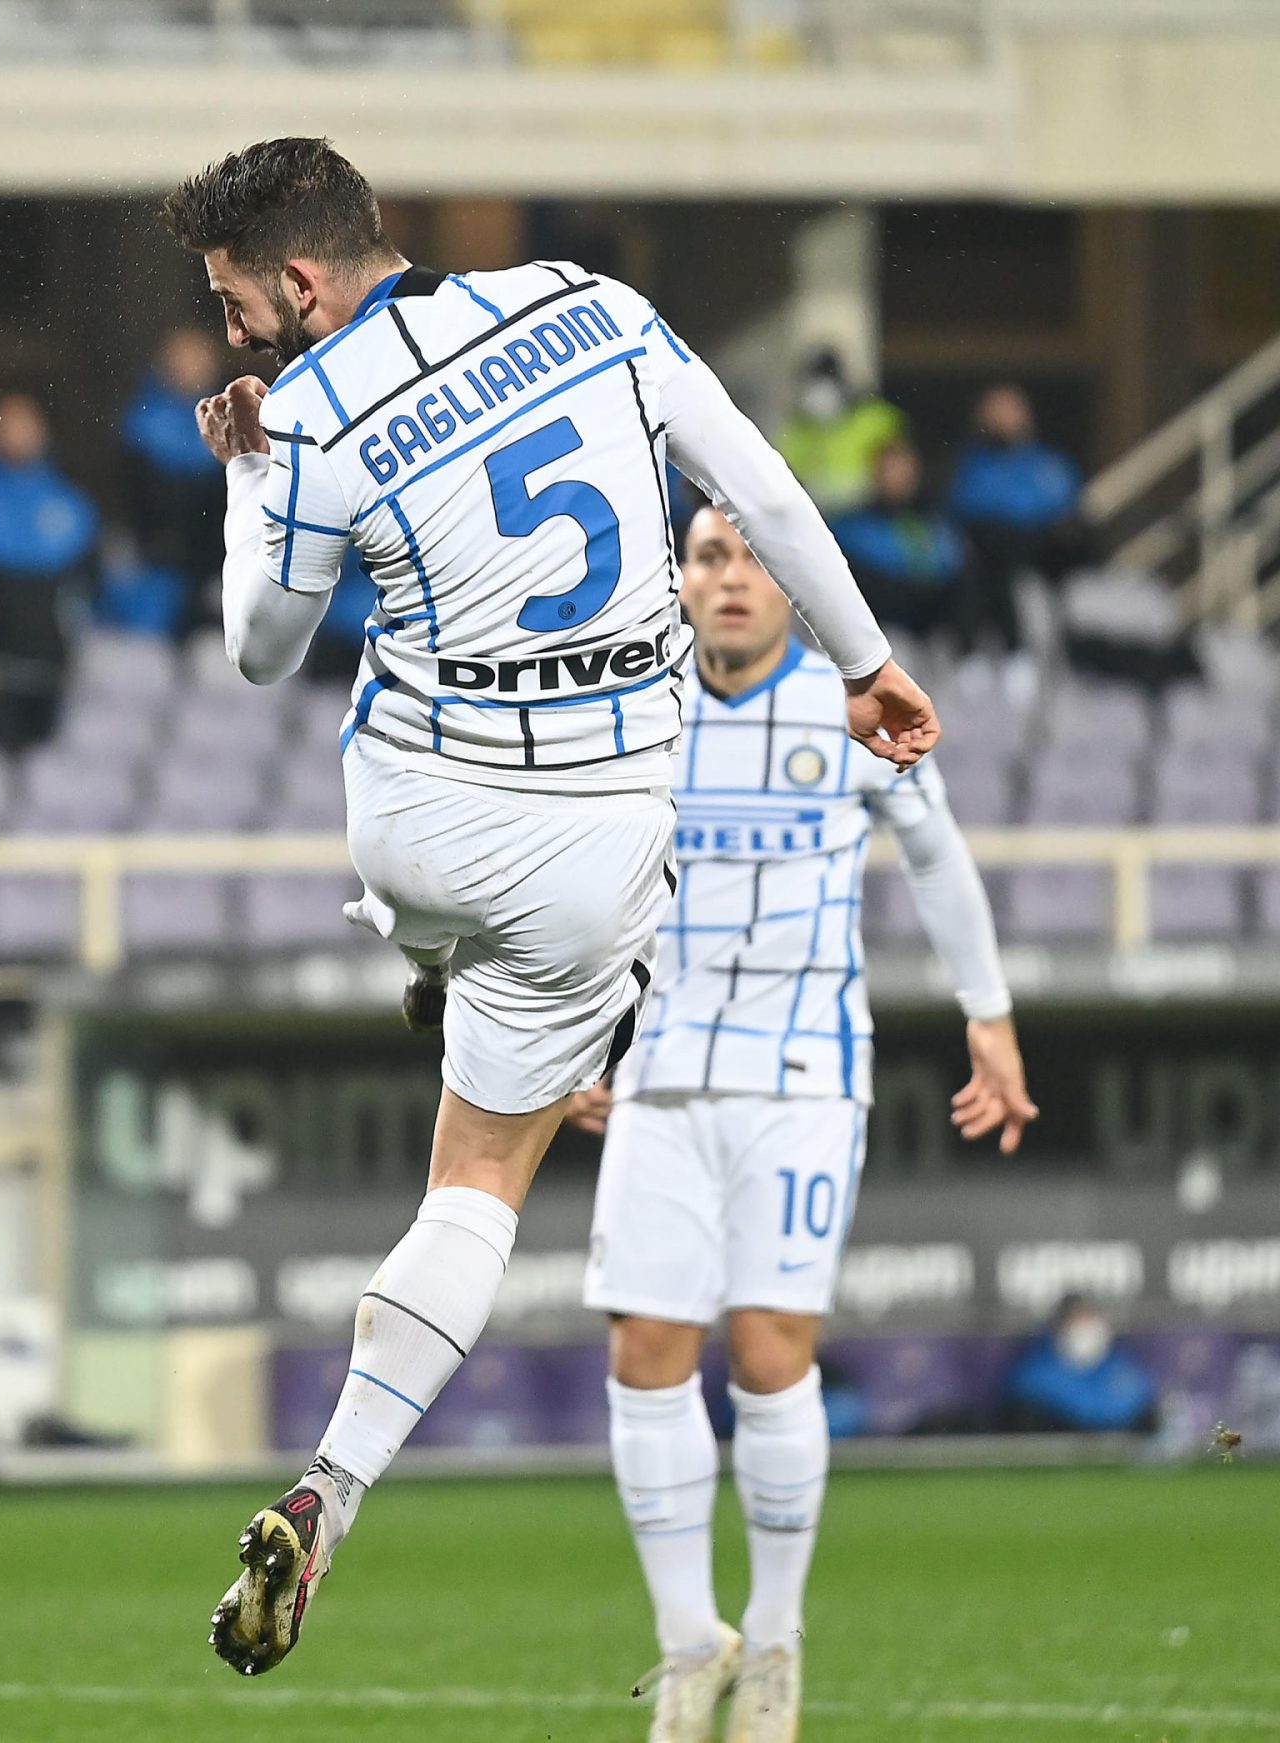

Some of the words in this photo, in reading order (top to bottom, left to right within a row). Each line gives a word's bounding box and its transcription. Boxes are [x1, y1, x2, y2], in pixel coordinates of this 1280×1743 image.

[359, 299, 624, 486] GAGLIARDINI
[483, 415, 622, 633] 5
[675, 812, 824, 850] RELLI
[776, 1167, 836, 1239] 10
